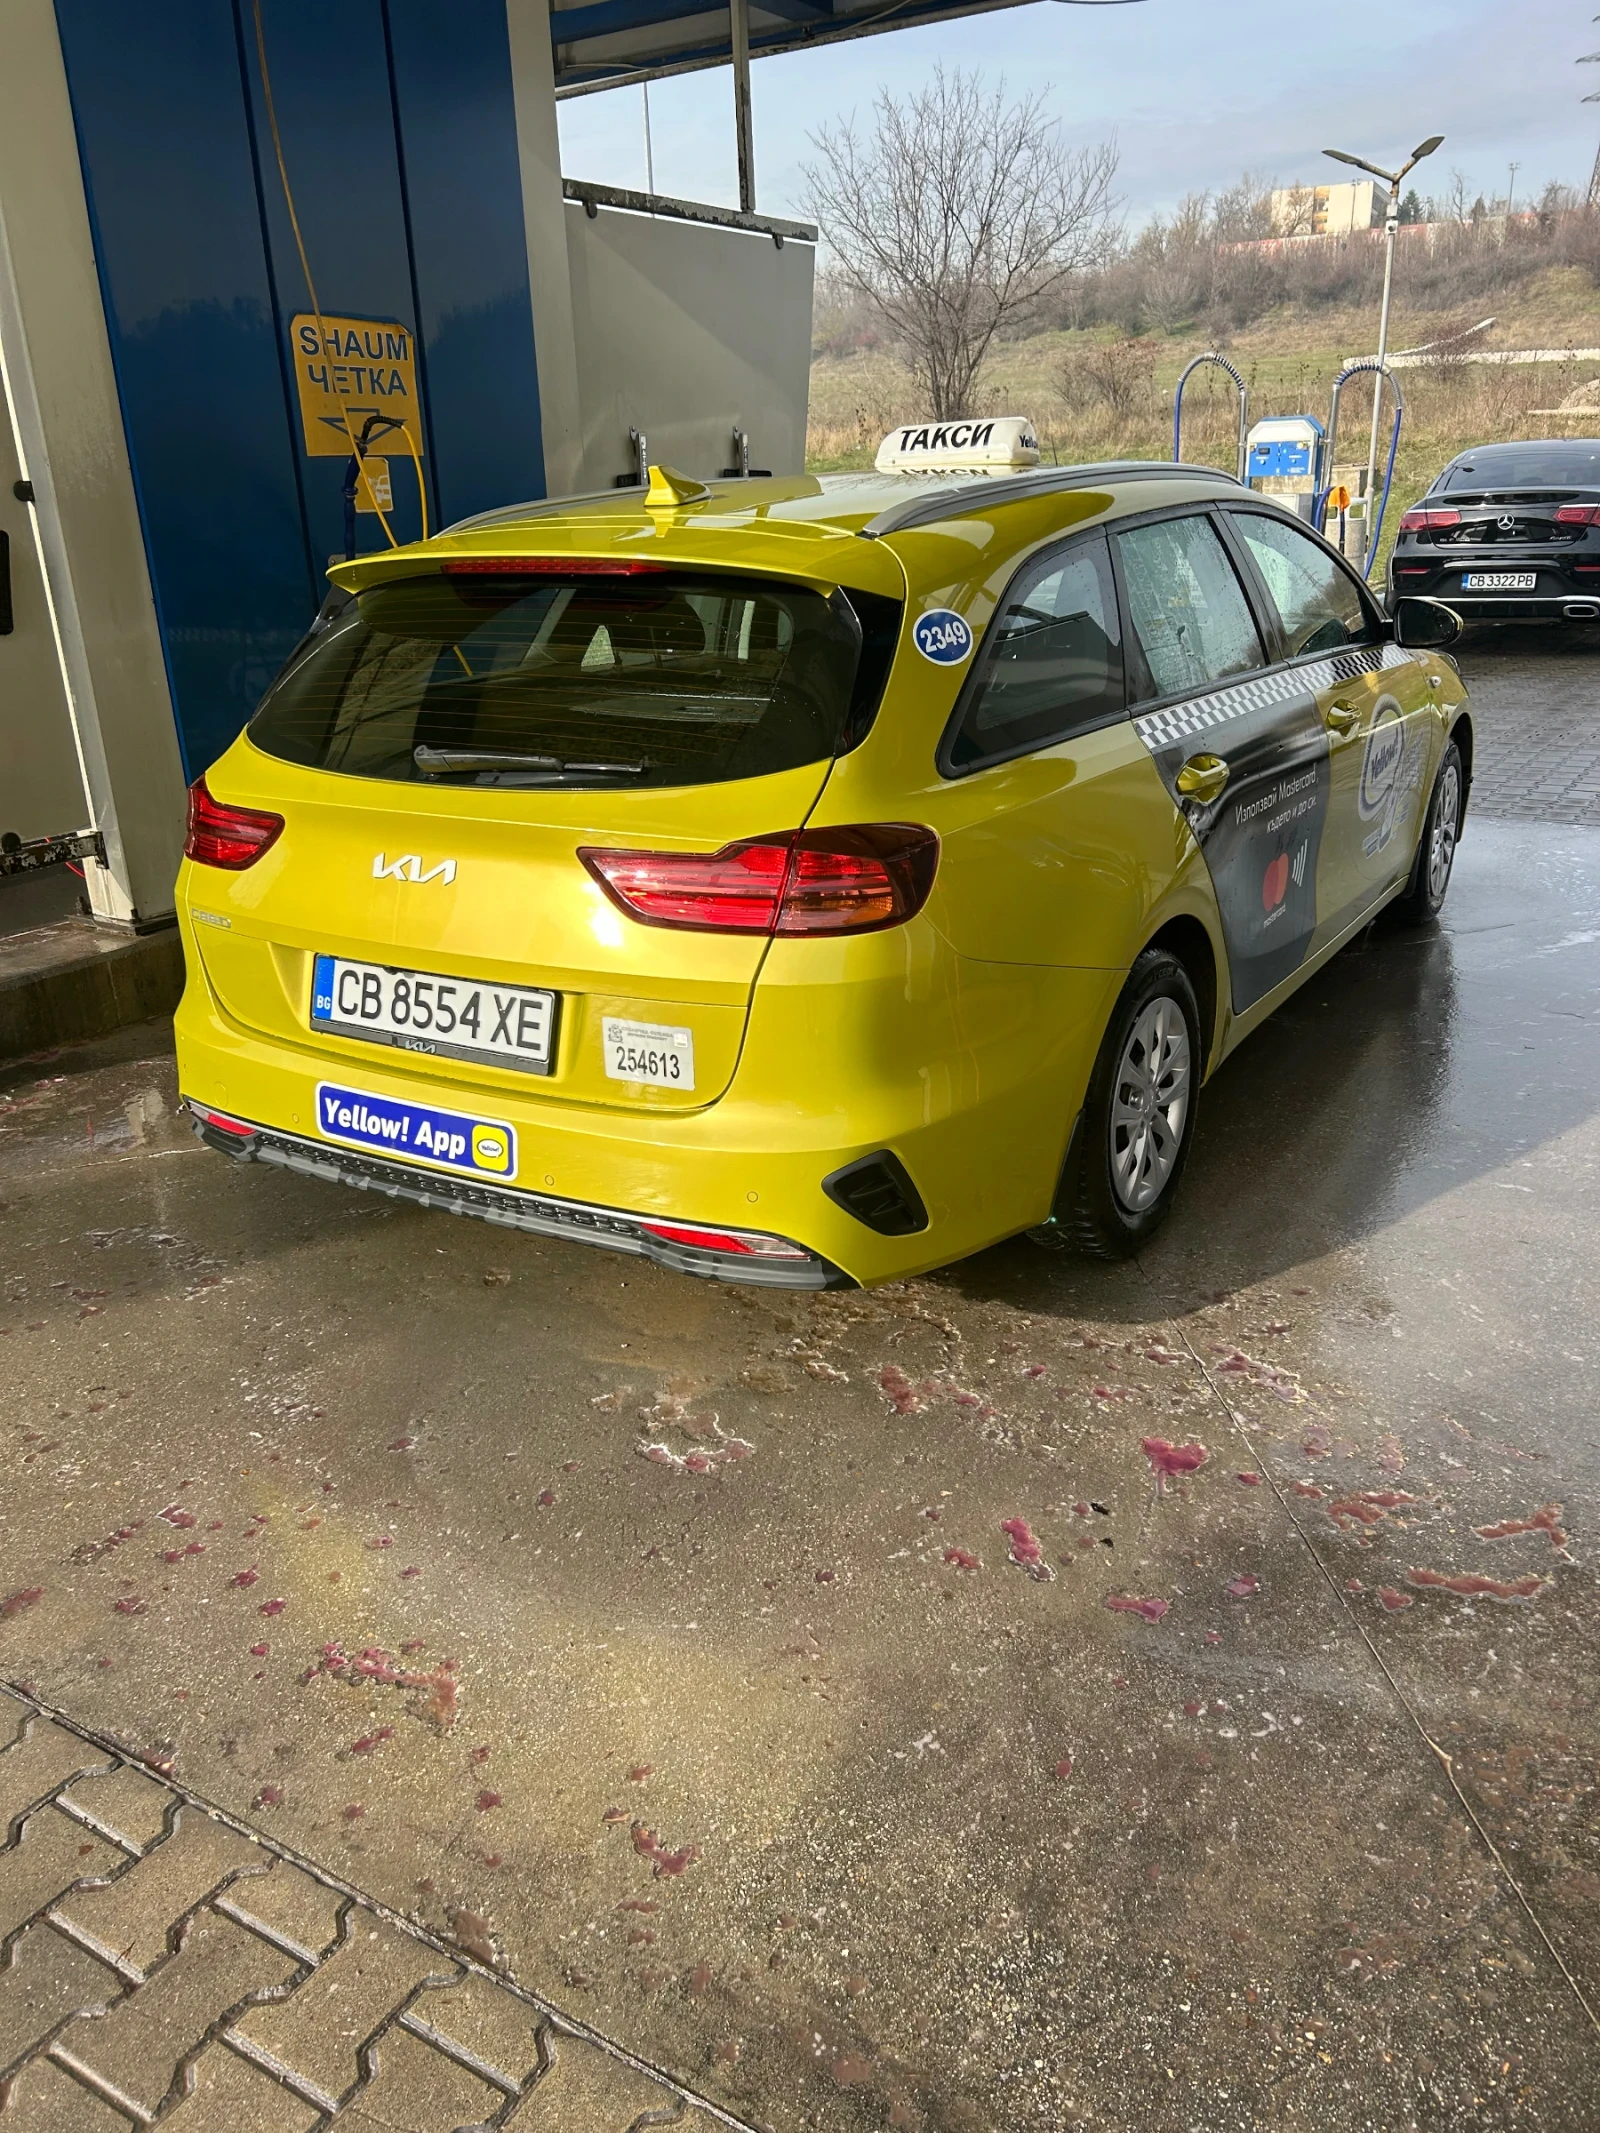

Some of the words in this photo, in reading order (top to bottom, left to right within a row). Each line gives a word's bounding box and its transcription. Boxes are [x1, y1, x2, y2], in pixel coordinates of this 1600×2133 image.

[300, 326, 409, 361] SHAUM
[307, 364, 408, 396] ЧЕТКА
[900, 423, 995, 451] ТАКСИ
[1019, 435, 1038, 449] Yello
[1469, 575, 1486, 587] CB
[1487, 575, 1516, 587] 3322
[920, 621, 967, 653] 2349
[1235, 786, 1278, 826] Използвай
[1266, 810, 1292, 834] където
[373, 852, 457, 887] KIA
[316, 994, 331, 1011] BG
[337, 969, 382, 1020] CB
[390, 978, 481, 1039] 8554
[490, 993, 543, 1051] XE
[616, 1046, 680, 1080] 254613
[324, 1097, 410, 1143] Yellow!
[414, 1120, 466, 1160] App
